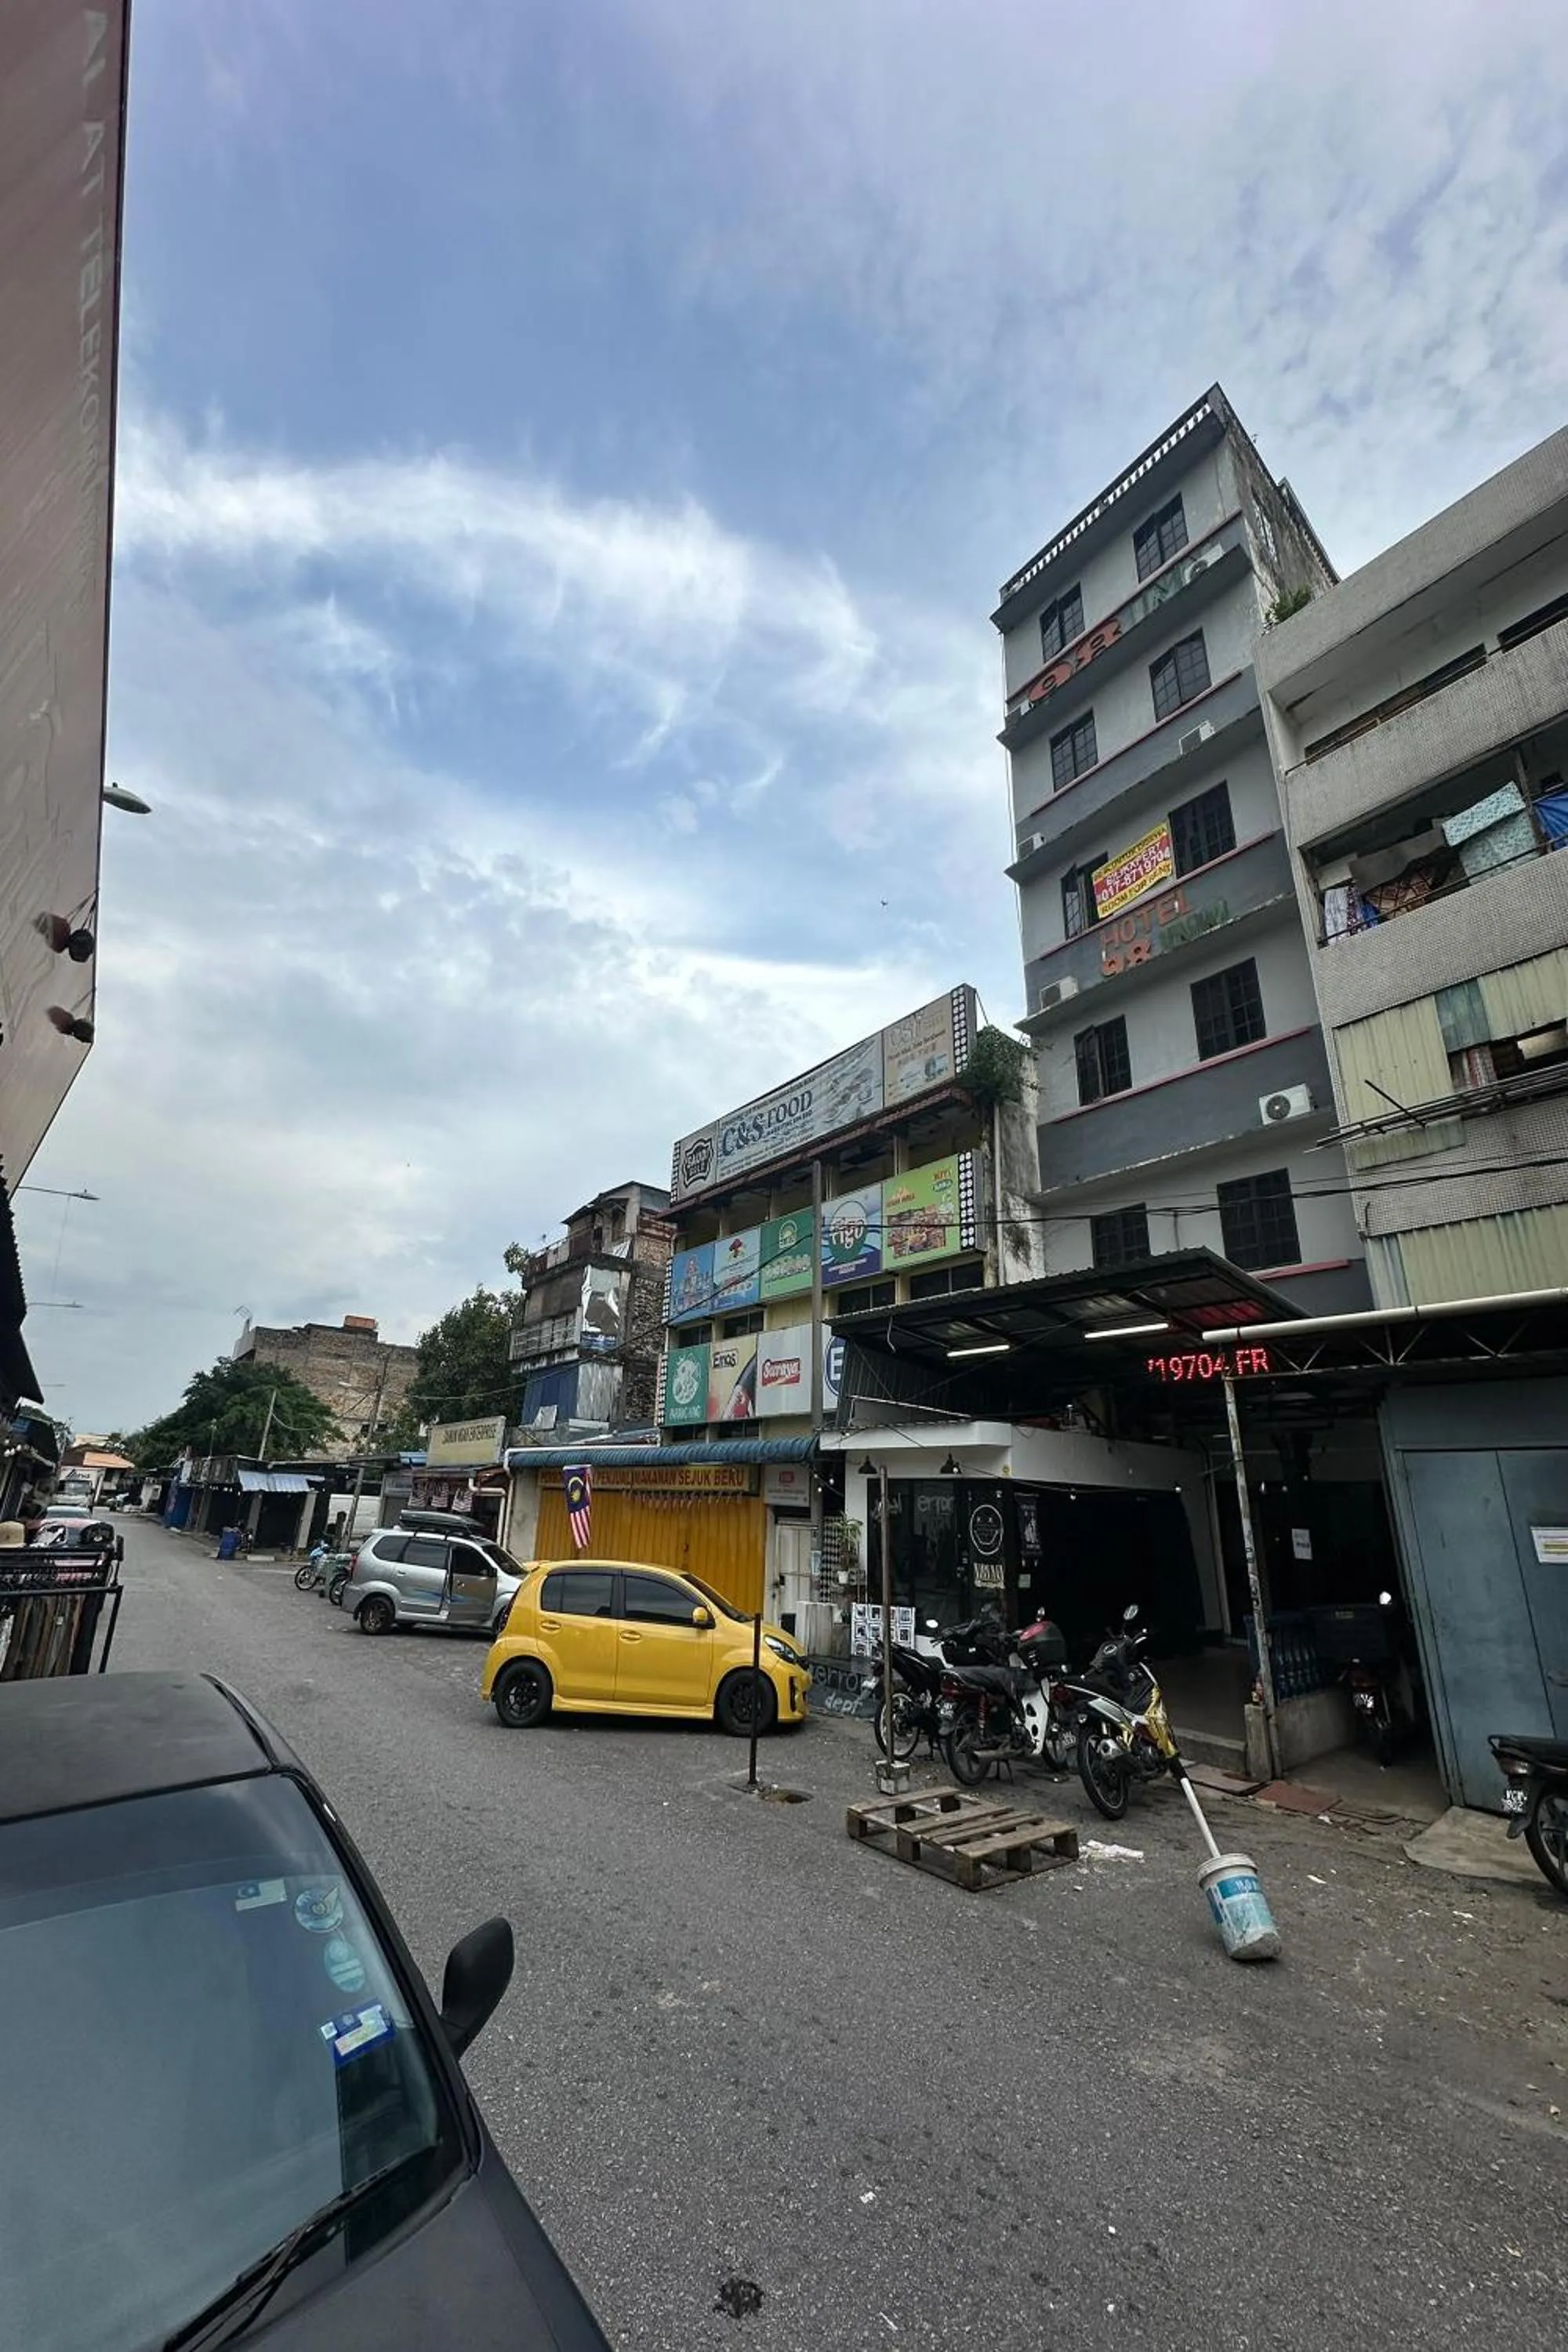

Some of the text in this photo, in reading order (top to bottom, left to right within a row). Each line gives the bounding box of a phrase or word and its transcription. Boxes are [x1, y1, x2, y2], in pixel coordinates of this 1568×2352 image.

[1101, 887, 1193, 949] HOTEL
[722, 1112, 764, 1156] C&S
[768, 1091, 813, 1128] FOOD
[1236, 1348, 1269, 1374] FR
[679, 1468, 711, 1486] SEJUK
[814, 1665, 863, 1693] erro
